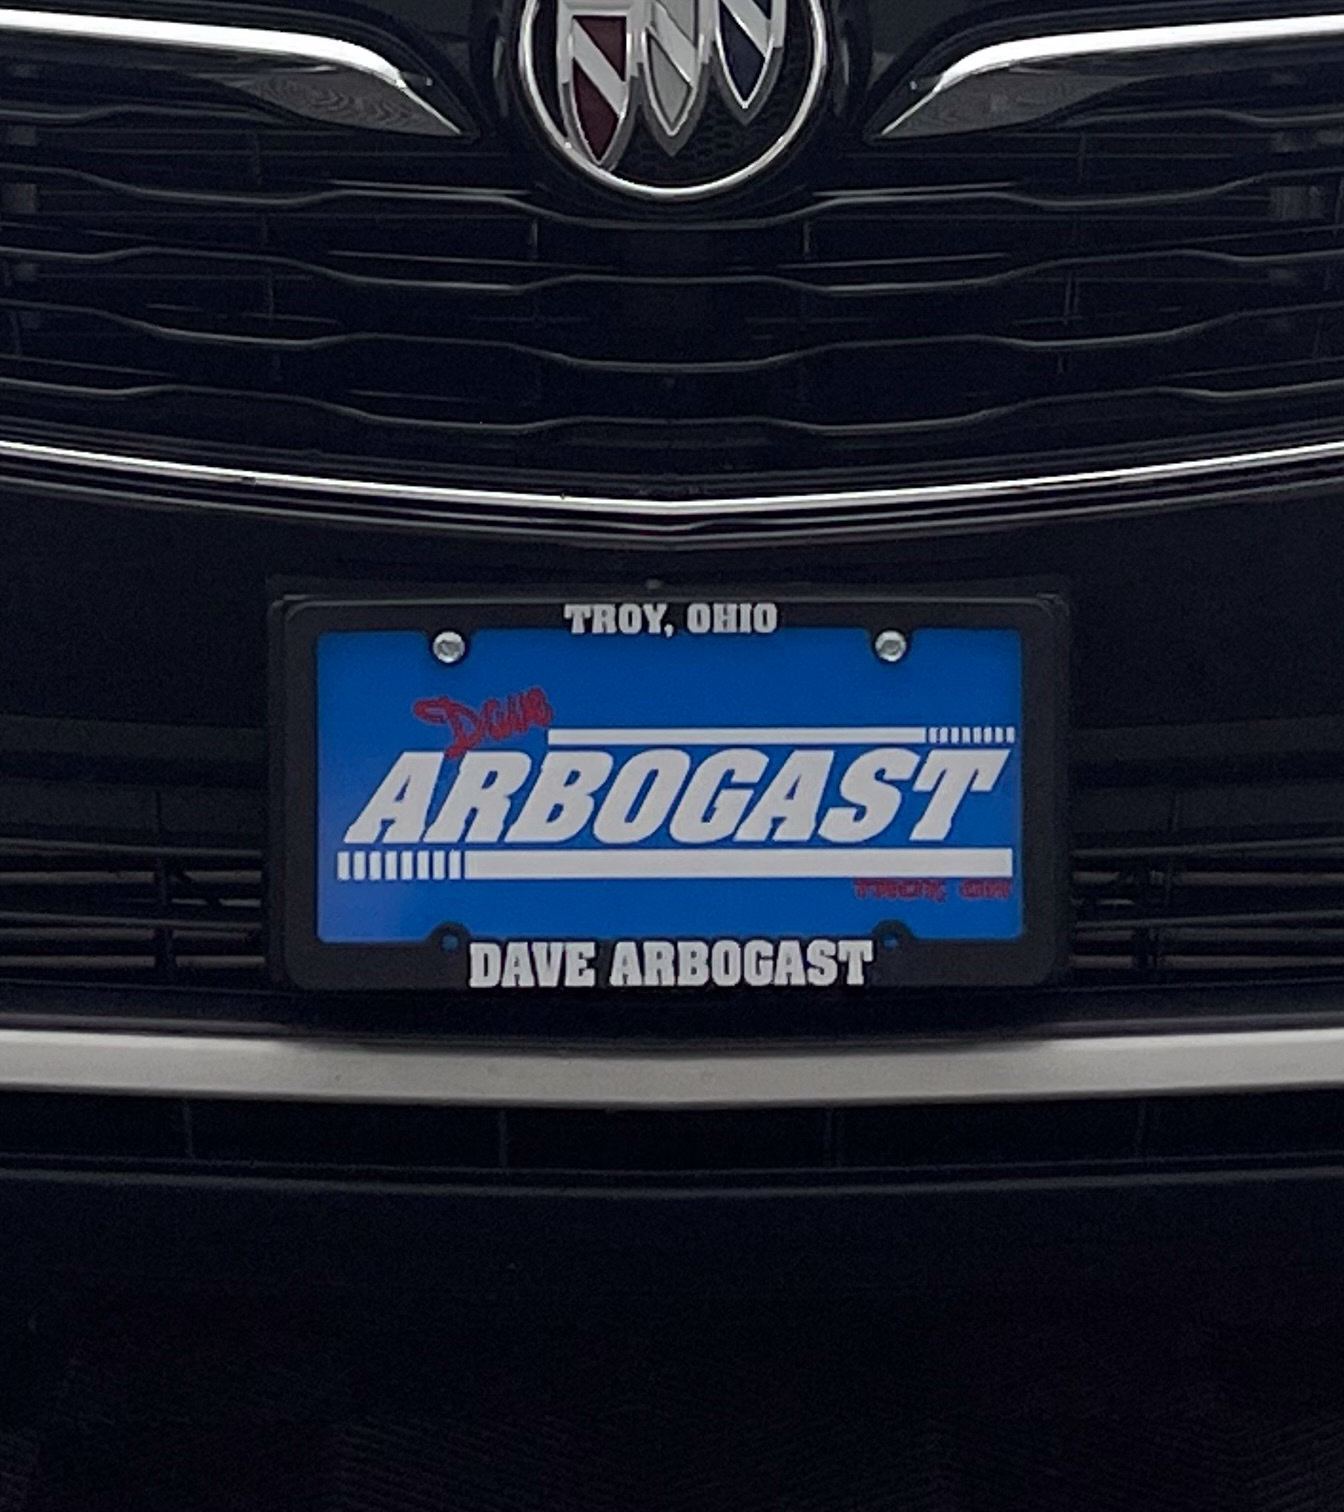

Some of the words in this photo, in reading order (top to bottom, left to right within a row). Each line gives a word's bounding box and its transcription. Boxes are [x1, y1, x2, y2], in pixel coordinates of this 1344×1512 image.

[564, 602, 674, 638] TROY,
[686, 602, 778, 635] OHIO
[343, 748, 1010, 845] ARBOGAST
[468, 941, 597, 988] DAVE
[609, 939, 874, 987] ARBOGAST
